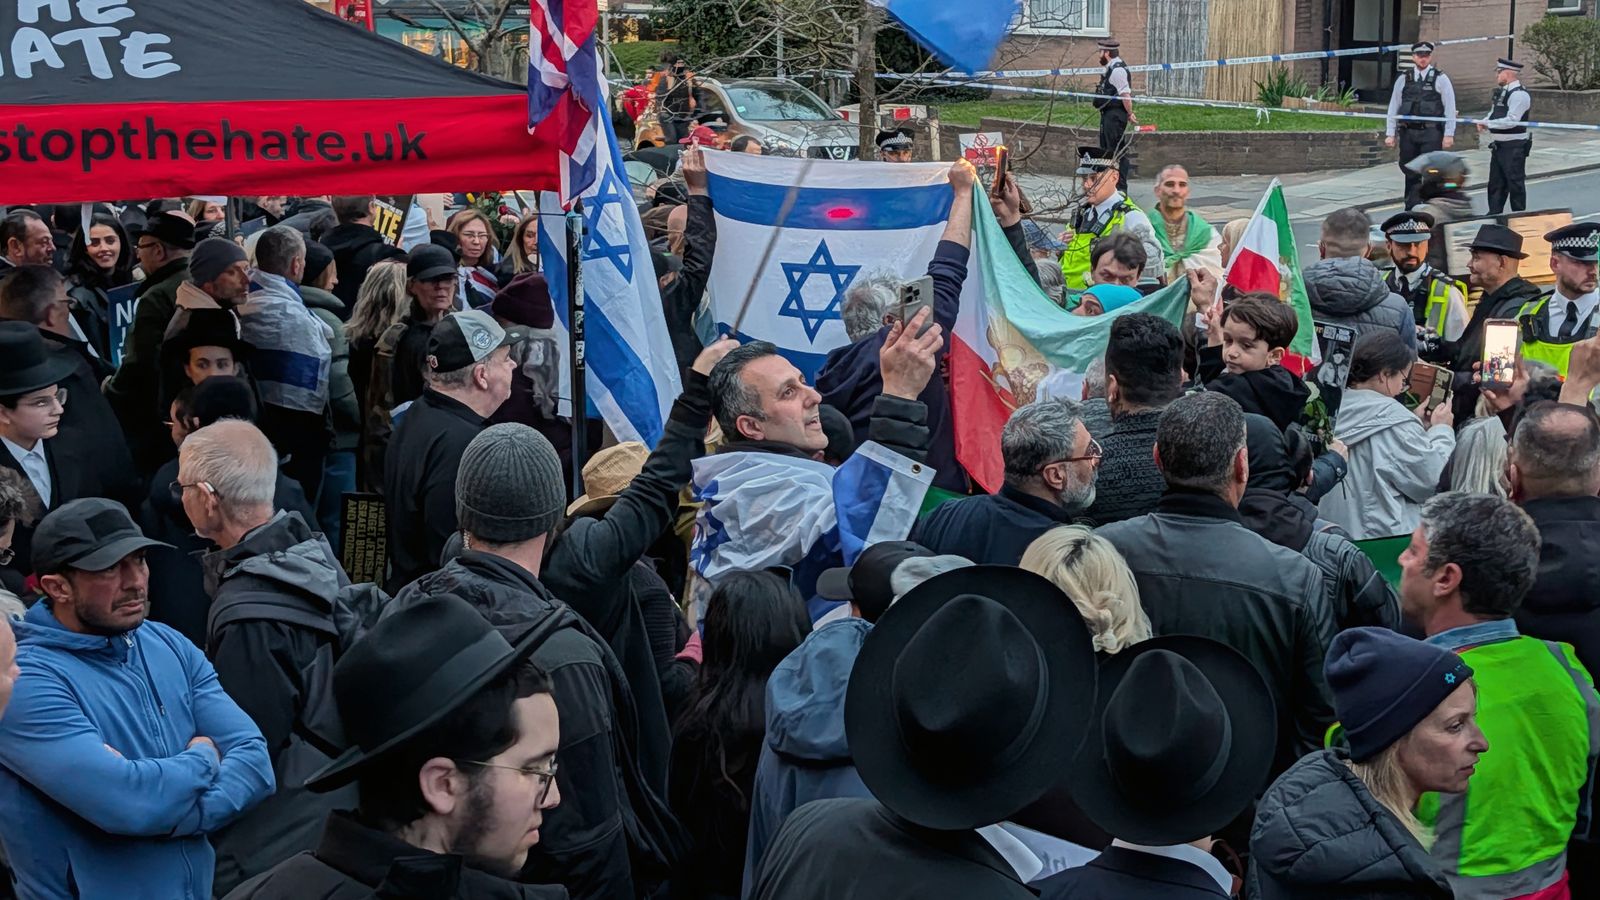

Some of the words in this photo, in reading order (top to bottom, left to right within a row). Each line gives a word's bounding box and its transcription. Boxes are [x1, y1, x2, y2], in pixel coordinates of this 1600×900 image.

[0, 27, 182, 79] ATE
[347, 499, 357, 520] AND
[356, 500, 368, 538] ISRAELI
[367, 501, 378, 537] TARGET
